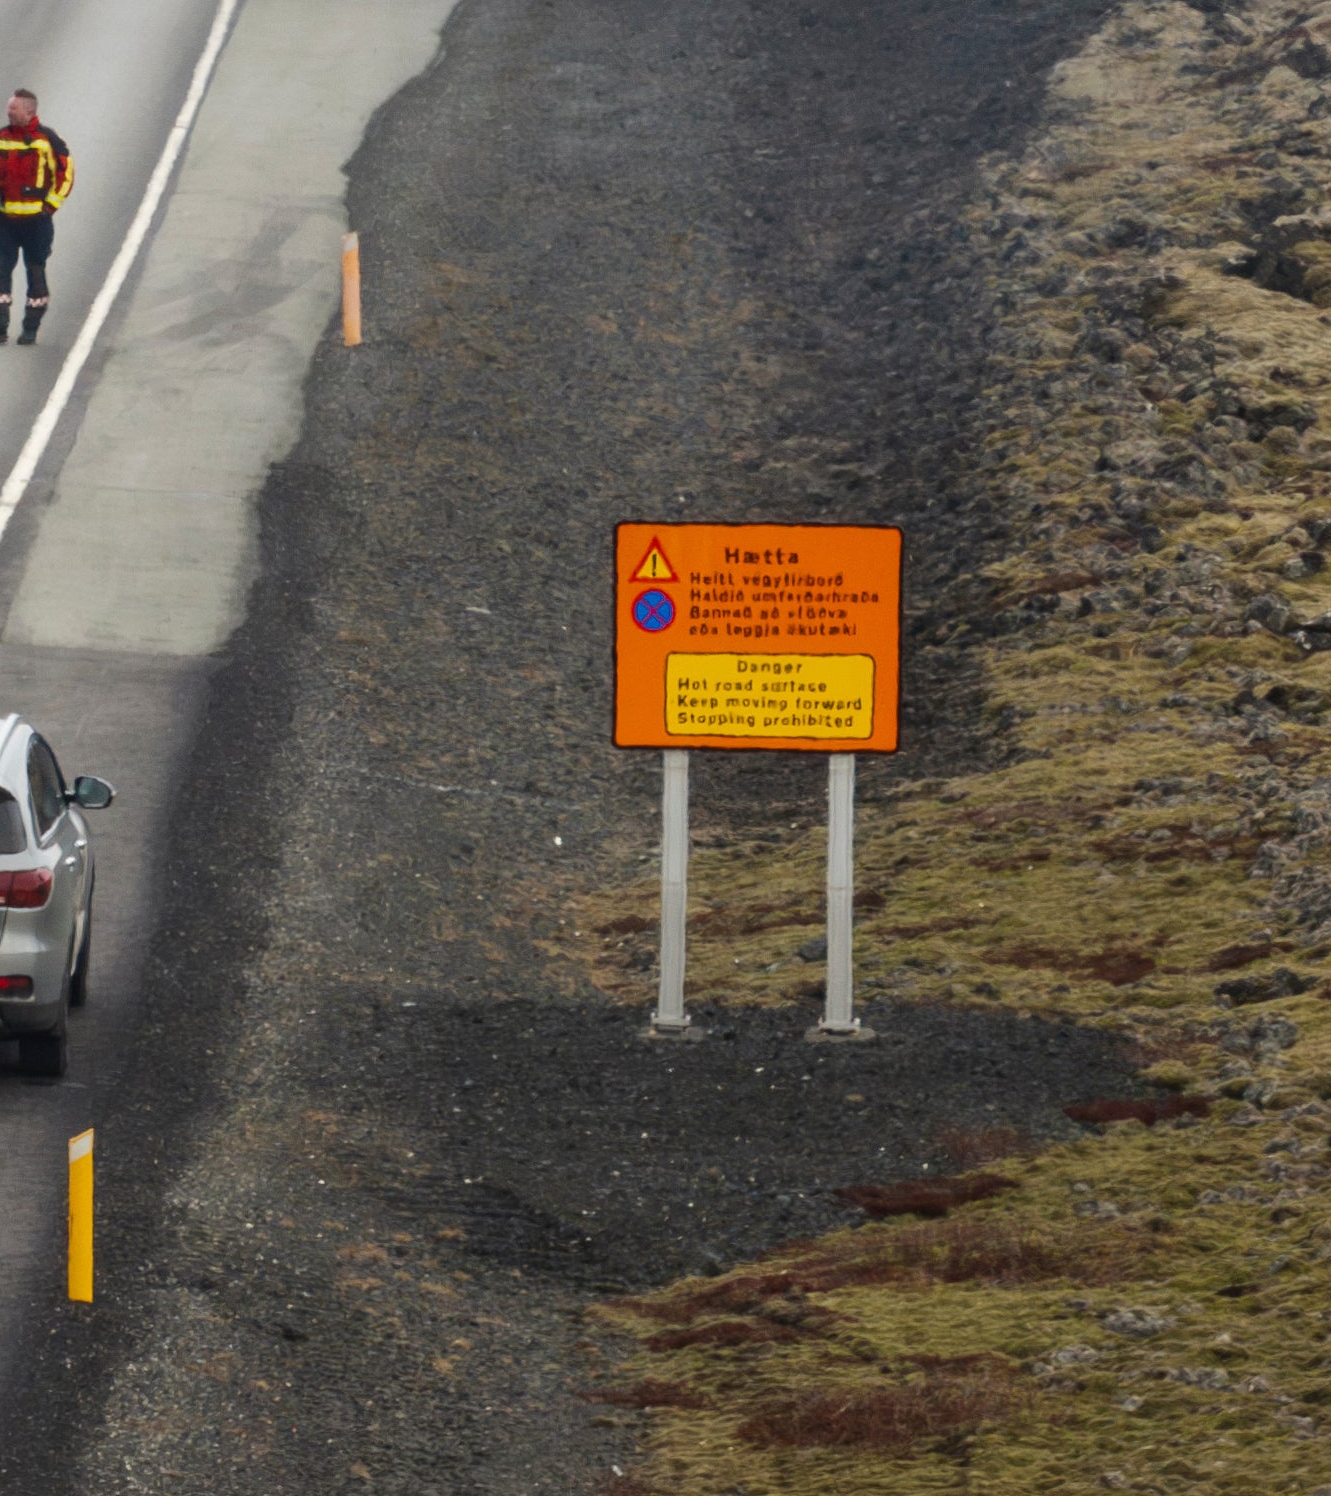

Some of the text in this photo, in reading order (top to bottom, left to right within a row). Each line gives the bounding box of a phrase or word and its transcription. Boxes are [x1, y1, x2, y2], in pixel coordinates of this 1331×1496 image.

[725, 547, 799, 565] Hætta
[737, 660, 804, 674] Danger
[677, 678, 707, 691] Hot
[715, 680, 753, 692] road
[677, 695, 863, 711] Keep moving forward
[677, 712, 854, 727] Stopping prohibited
